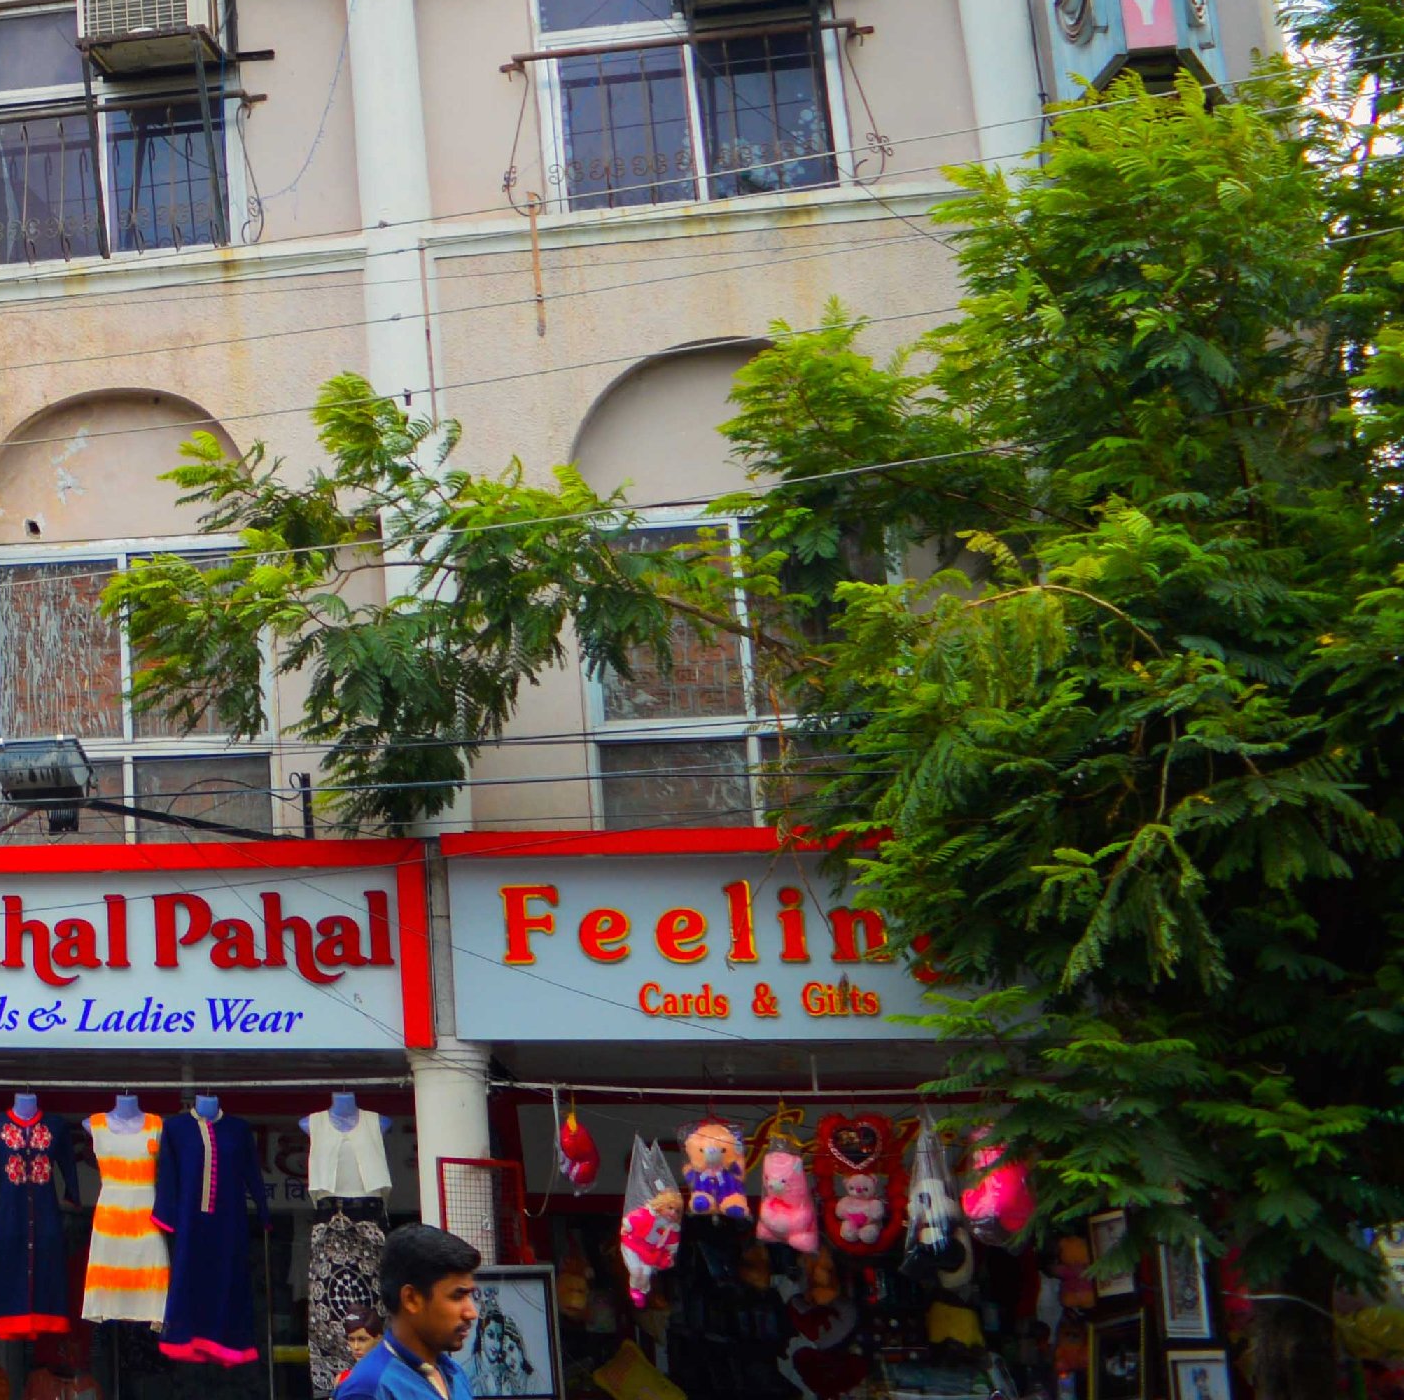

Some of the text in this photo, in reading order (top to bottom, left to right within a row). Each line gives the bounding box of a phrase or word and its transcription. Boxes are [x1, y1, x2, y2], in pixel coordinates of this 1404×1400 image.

[152, 889, 397, 985] Pahal
[499, 879, 963, 984] Feelin
[27, 998, 68, 1031] &
[74, 995, 196, 1035] Ladies
[207, 997, 304, 1035] Wear
[638, 981, 880, 1018] Cards & Gifts
